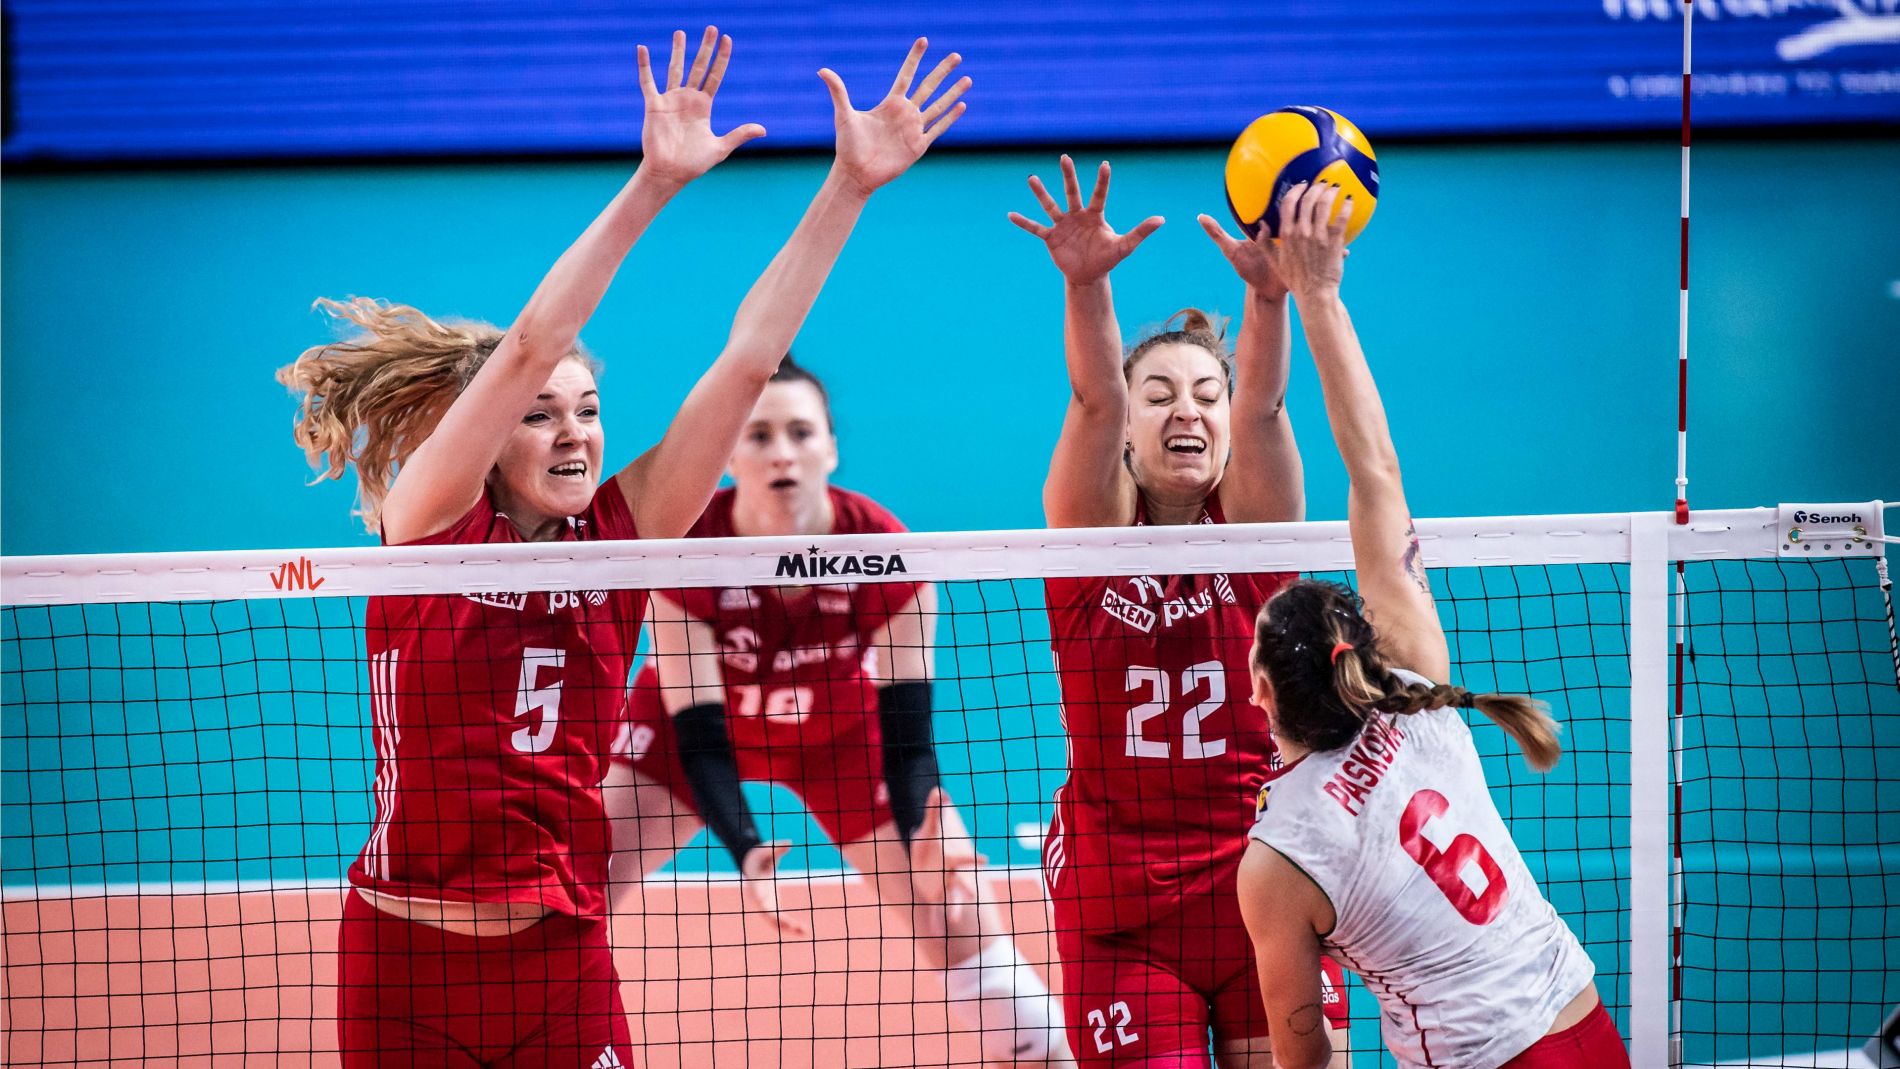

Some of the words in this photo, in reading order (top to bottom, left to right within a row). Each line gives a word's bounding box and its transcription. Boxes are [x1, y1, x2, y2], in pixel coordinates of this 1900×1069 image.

[1809, 513, 1861, 523] Senoh
[270, 555, 325, 591] VNL
[469, 591, 522, 608] LEN
[1104, 592, 1152, 629] ORLEN
[511, 646, 566, 753] 5
[1125, 659, 1227, 760] 22
[1398, 788, 1510, 926] 6
[1087, 1000, 1139, 1054] 22
